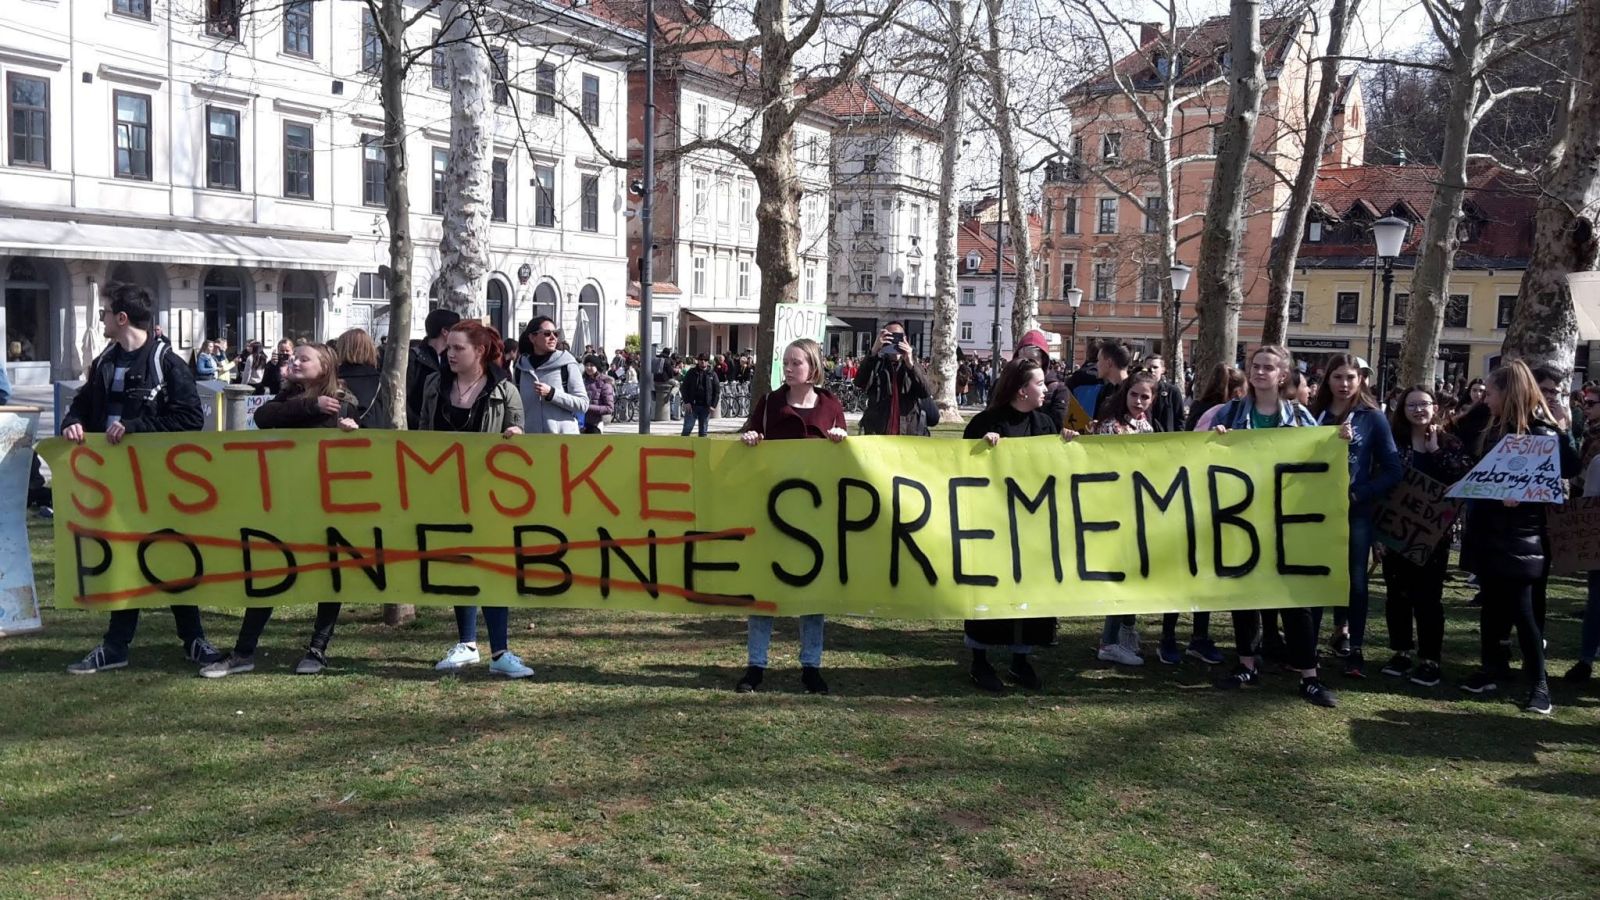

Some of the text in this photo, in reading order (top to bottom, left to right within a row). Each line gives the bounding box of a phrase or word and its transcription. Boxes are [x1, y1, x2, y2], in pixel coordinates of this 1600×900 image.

[777, 305, 826, 341] PROFIT
[70, 438, 695, 520] SISTEMSKE
[1521, 486, 1551, 501] NAS
[74, 523, 758, 608] PODNEBNE
[767, 462, 1332, 588] SPREMEMBE
